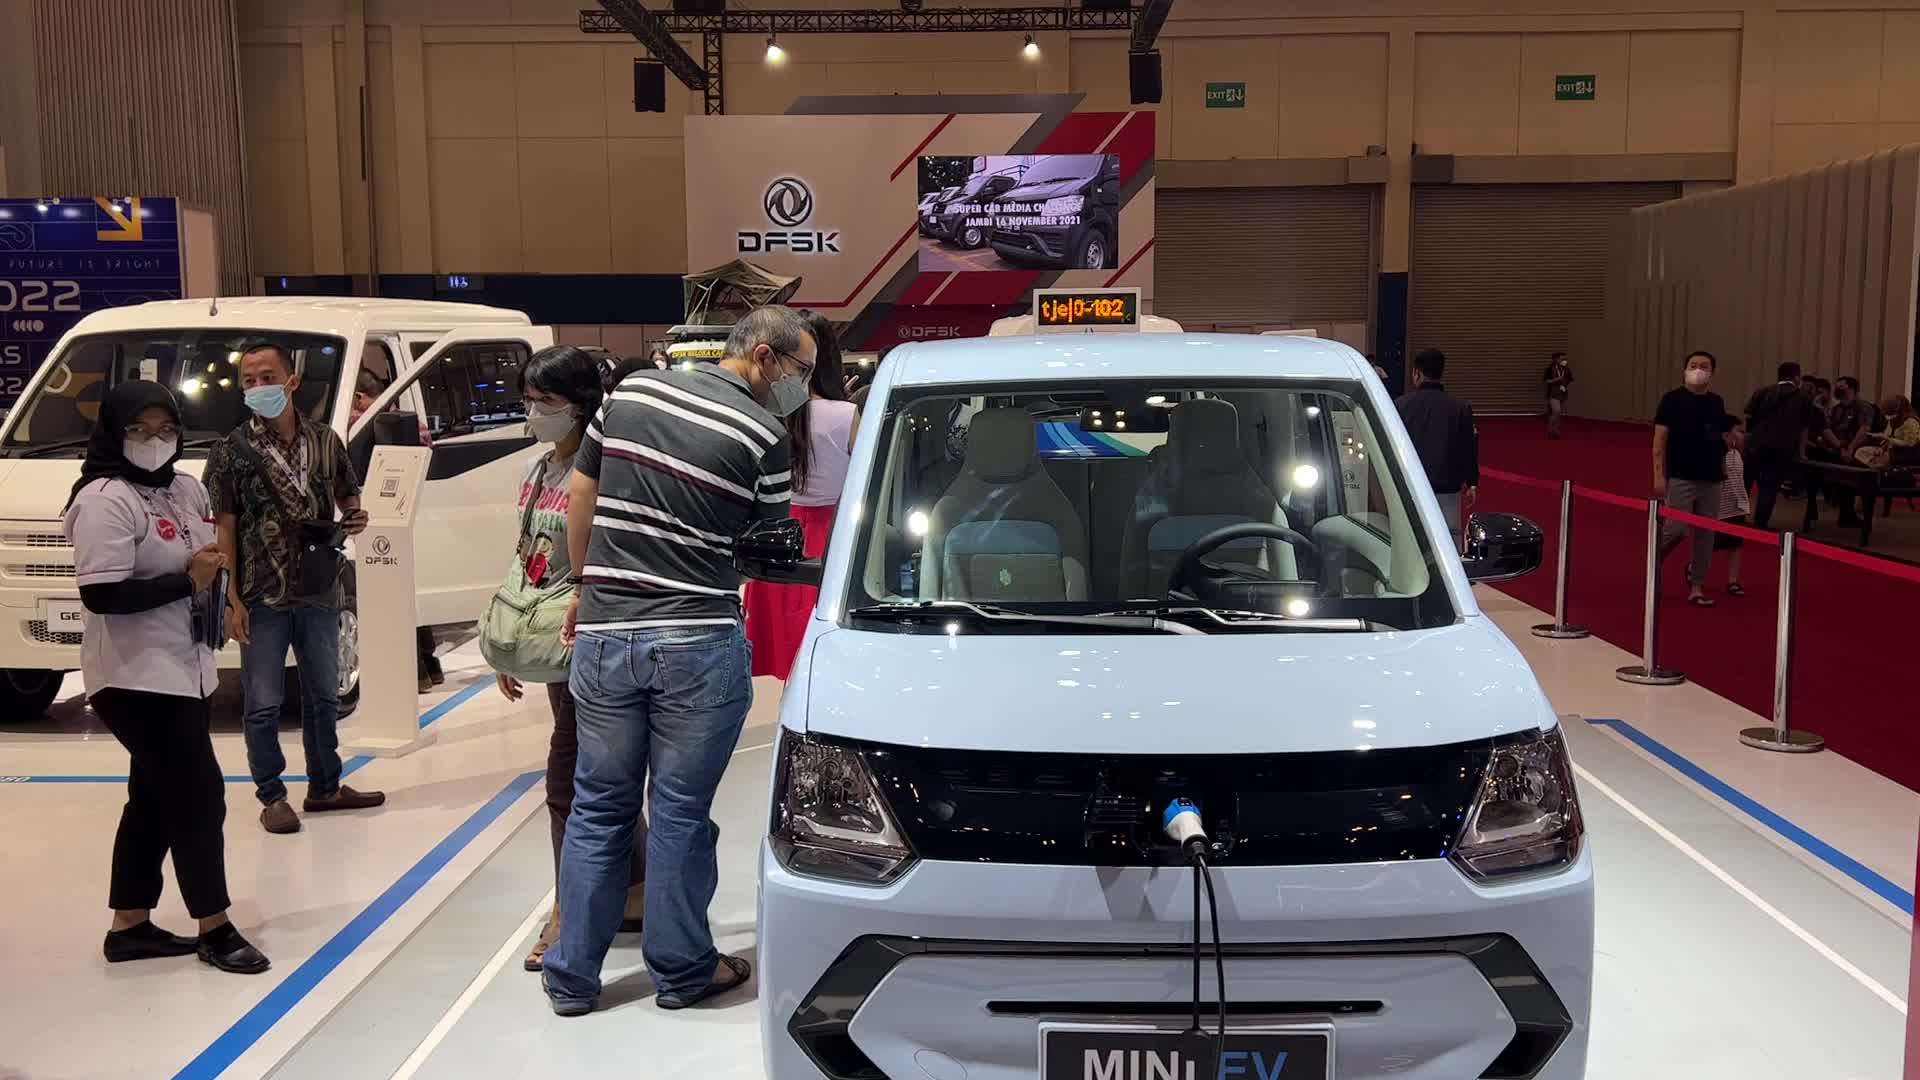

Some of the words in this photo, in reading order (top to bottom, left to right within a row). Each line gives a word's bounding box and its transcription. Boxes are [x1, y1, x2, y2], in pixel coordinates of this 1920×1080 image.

[1557, 84, 1575, 92] EXIT
[1207, 91, 1226, 99] EXIT
[954, 203, 982, 214] SUPER
[984, 203, 1001, 213] CAB
[1003, 203, 1031, 213] MEDIA
[966, 217, 993, 227] JAMBI
[996, 216, 1007, 226] 16
[1008, 216, 1058, 226] NOVEMBER
[1059, 215, 1081, 225] 2021
[738, 231, 840, 253] DFSK
[911, 326, 961, 337] DFSK
[0, 346, 21, 364] S
[365, 556, 398, 565] DFSK
